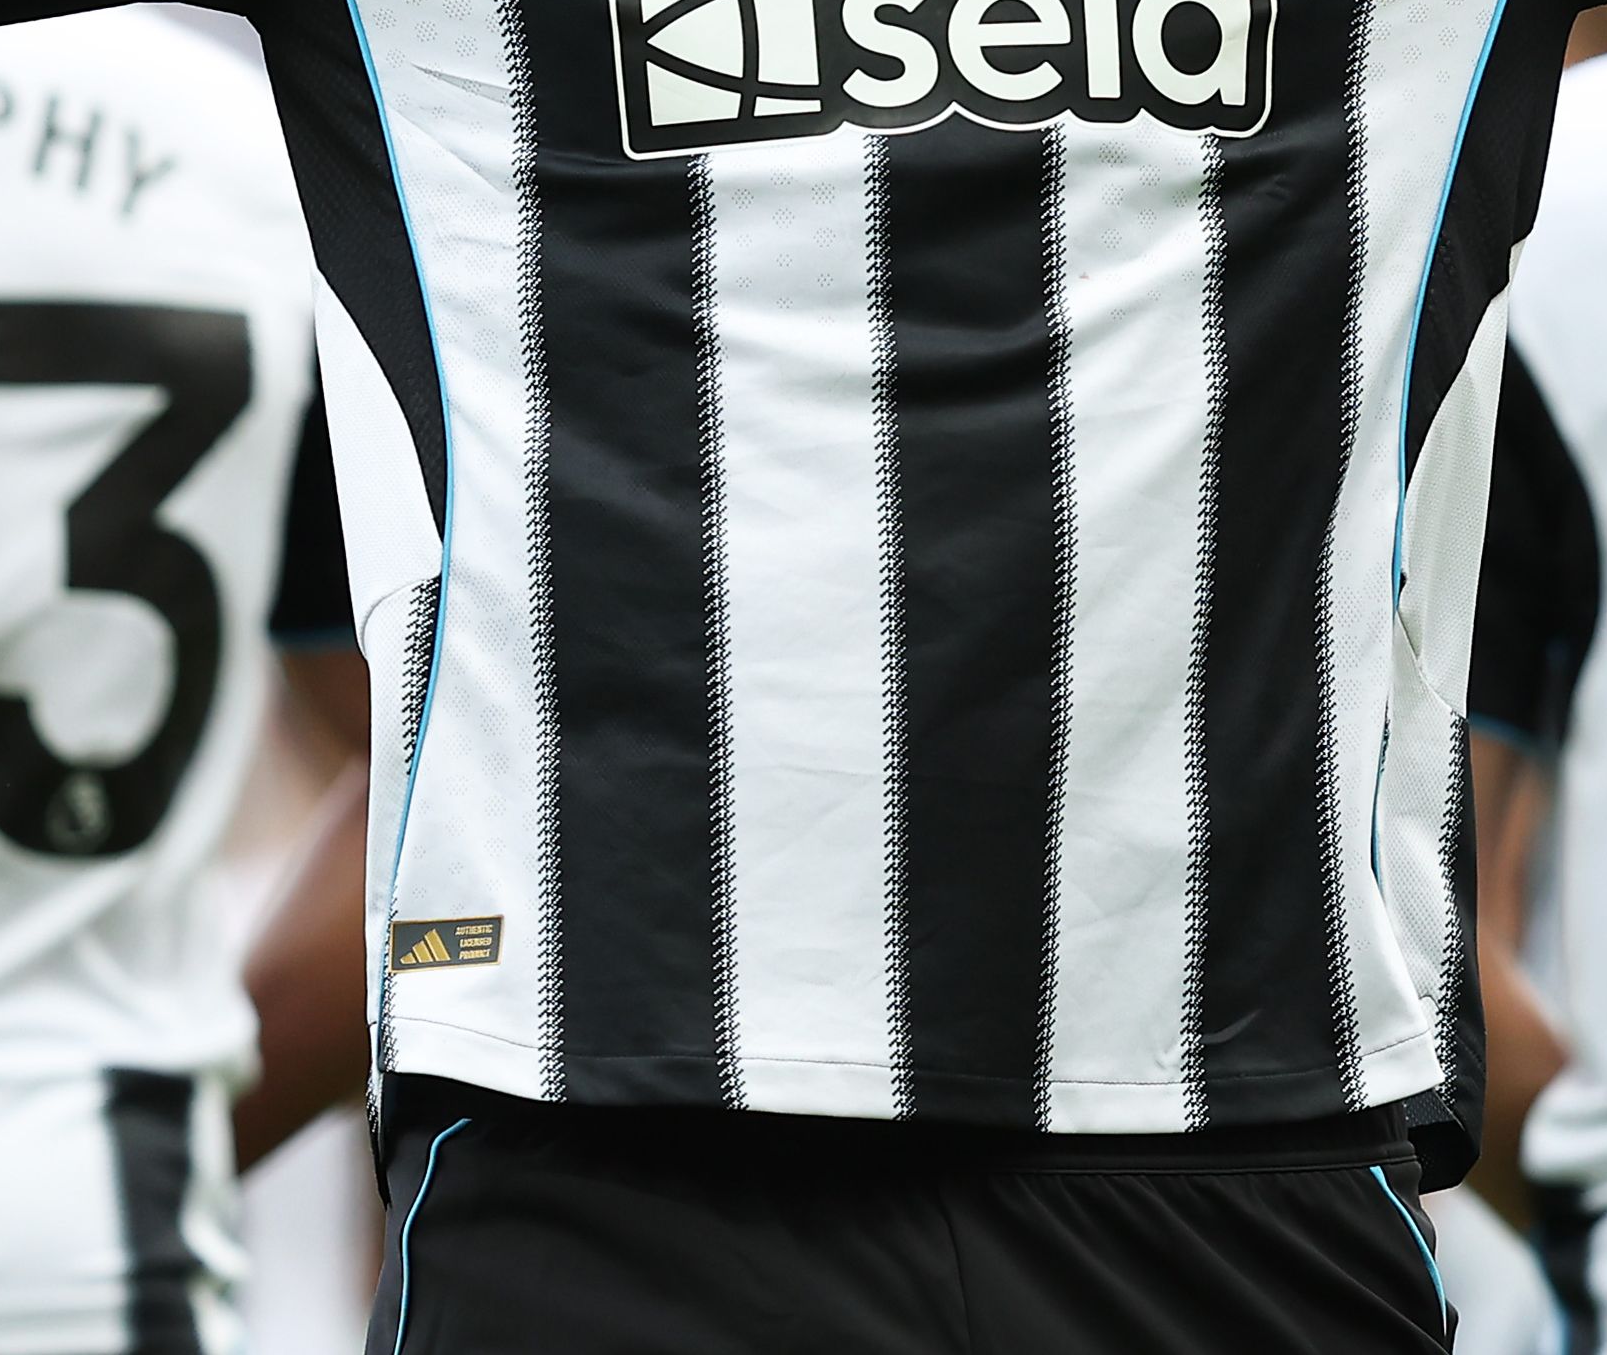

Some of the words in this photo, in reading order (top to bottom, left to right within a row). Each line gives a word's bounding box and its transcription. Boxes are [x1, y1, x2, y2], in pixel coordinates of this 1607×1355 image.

[455, 924, 493, 935] AUTHENTIC
[459, 937, 492, 948] LICENSED
[458, 949, 491, 959] PRODUCT
